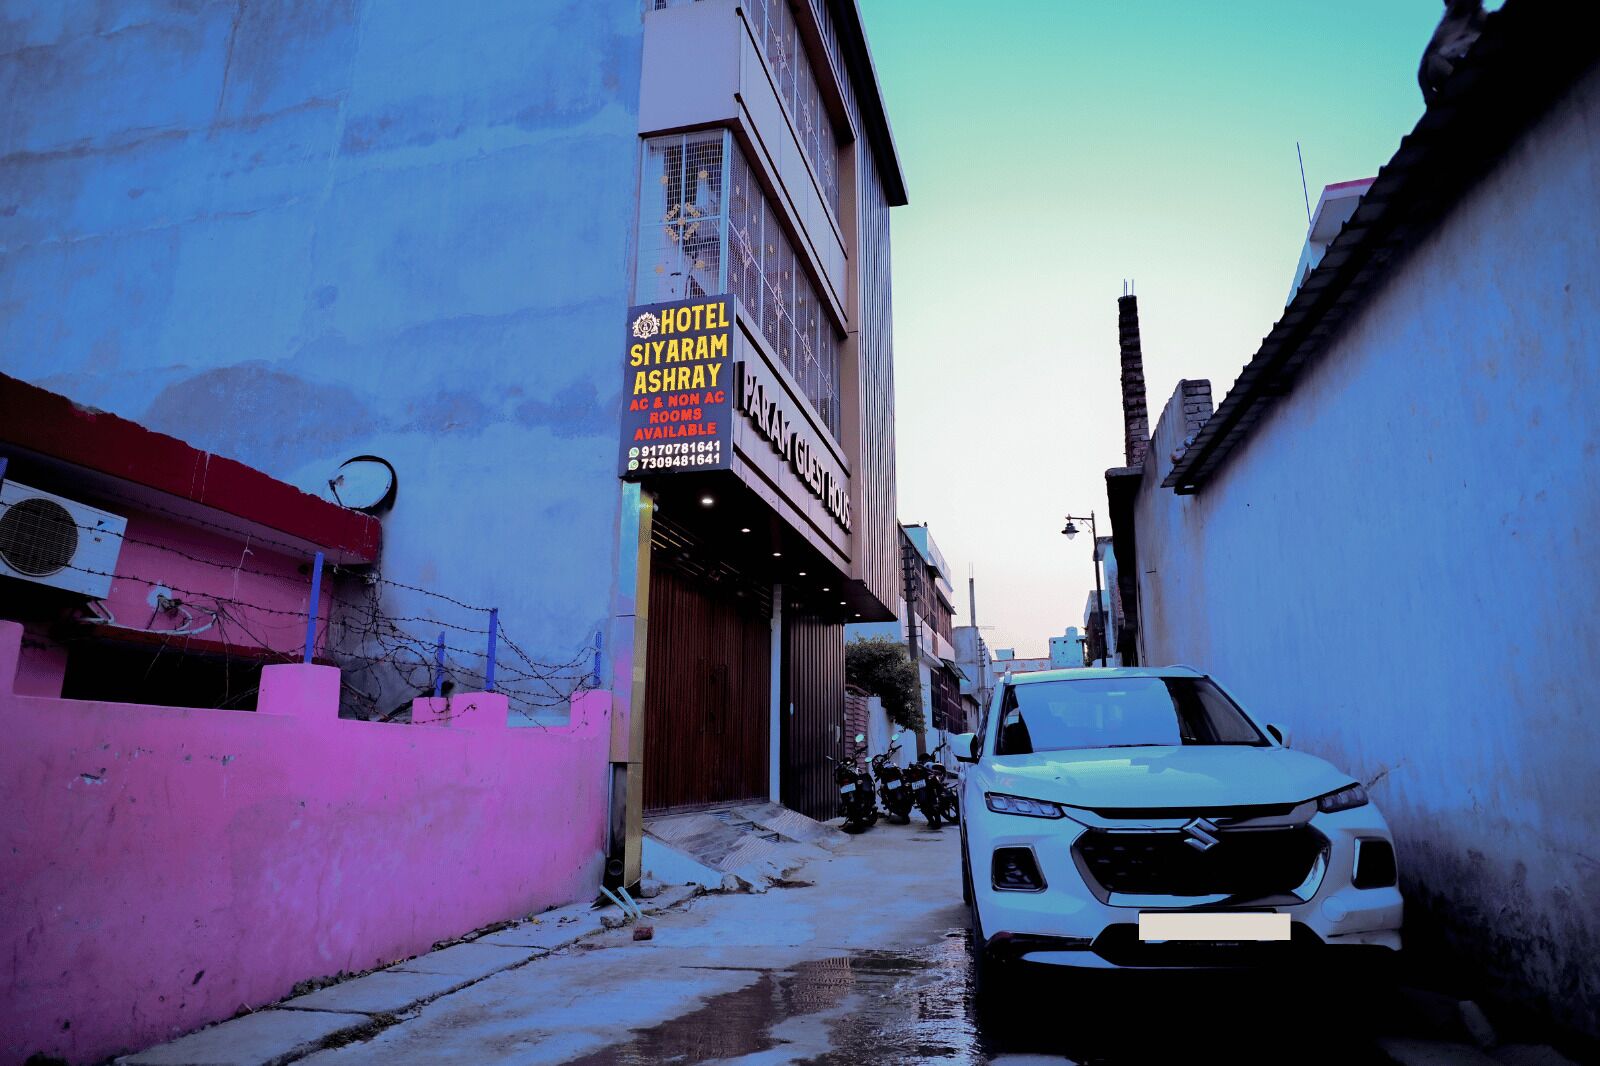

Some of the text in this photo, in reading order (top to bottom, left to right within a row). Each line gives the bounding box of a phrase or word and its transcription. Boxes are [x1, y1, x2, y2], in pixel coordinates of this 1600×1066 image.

[660, 302, 730, 335] HOTEL
[630, 333, 728, 367] SIYARAM
[633, 362, 722, 395] ASHRAY
[629, 390, 726, 412] AC & NON AC
[649, 407, 703, 425] ROOMS
[633, 422, 717, 441] AVAILABLE
[743, 361, 791, 461] PARAM
[795, 431, 825, 500] GUEST
[641, 440, 721, 457] 9170781641
[641, 452, 720, 469] 7309481641
